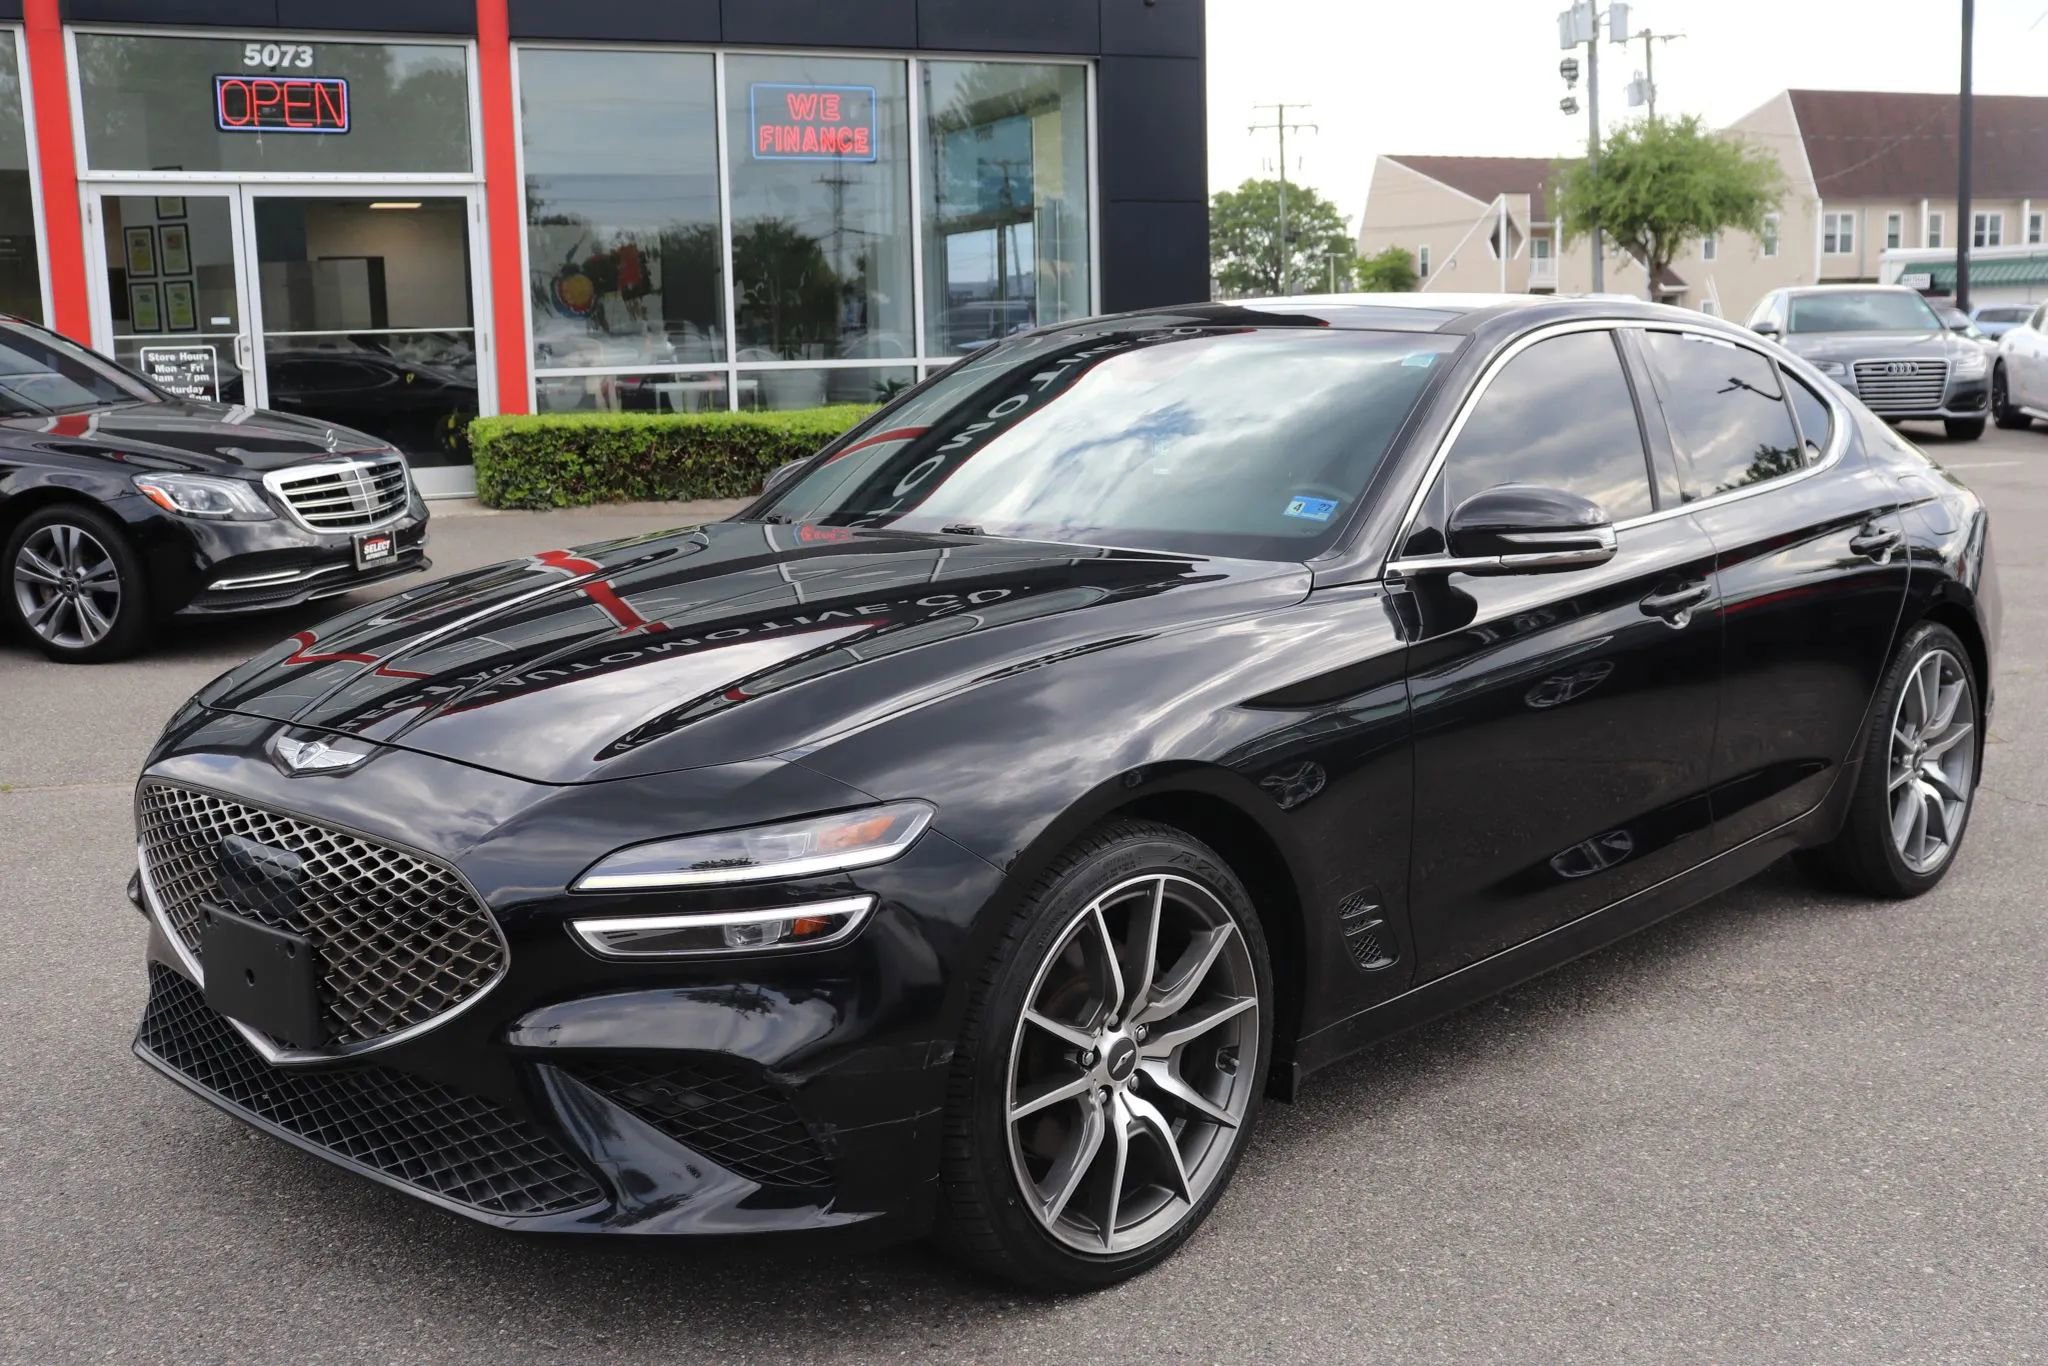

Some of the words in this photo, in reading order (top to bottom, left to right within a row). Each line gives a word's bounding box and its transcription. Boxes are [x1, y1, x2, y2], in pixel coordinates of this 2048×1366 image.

[243, 43, 314, 68] 5073
[221, 79, 345, 127] OPEN
[786, 92, 841, 121] WE
[759, 124, 869, 154] FINANCE
[148, 353, 175, 361] Store
[179, 352, 209, 361] Hours
[155, 365, 177, 373] Mon
[190, 364, 204, 372] Fri
[364, 540, 390, 555] SELECT
